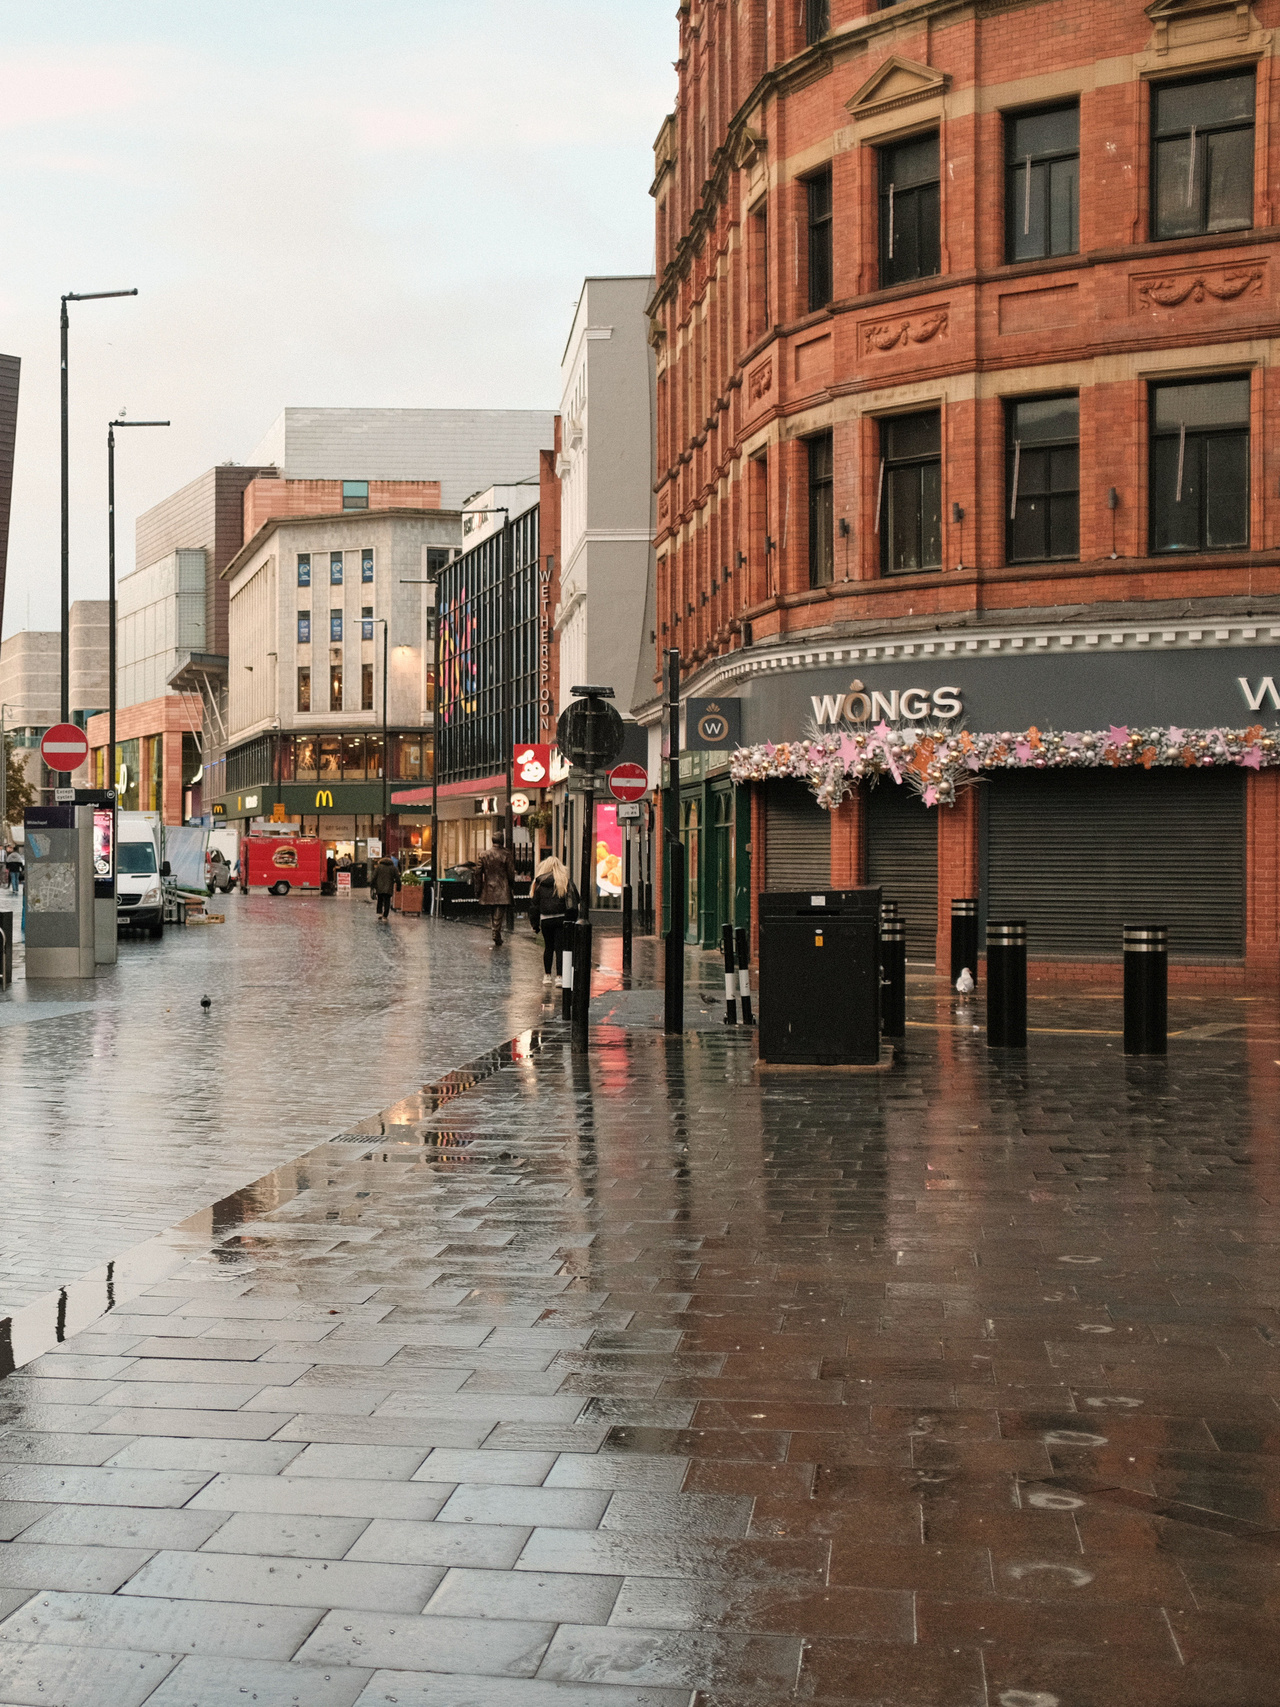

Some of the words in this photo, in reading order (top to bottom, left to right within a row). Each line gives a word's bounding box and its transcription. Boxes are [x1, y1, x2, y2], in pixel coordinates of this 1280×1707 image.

[539, 570, 551, 730] WETHERSPOON
[811, 686, 963, 725] WONGS
[704, 722, 722, 735] W
